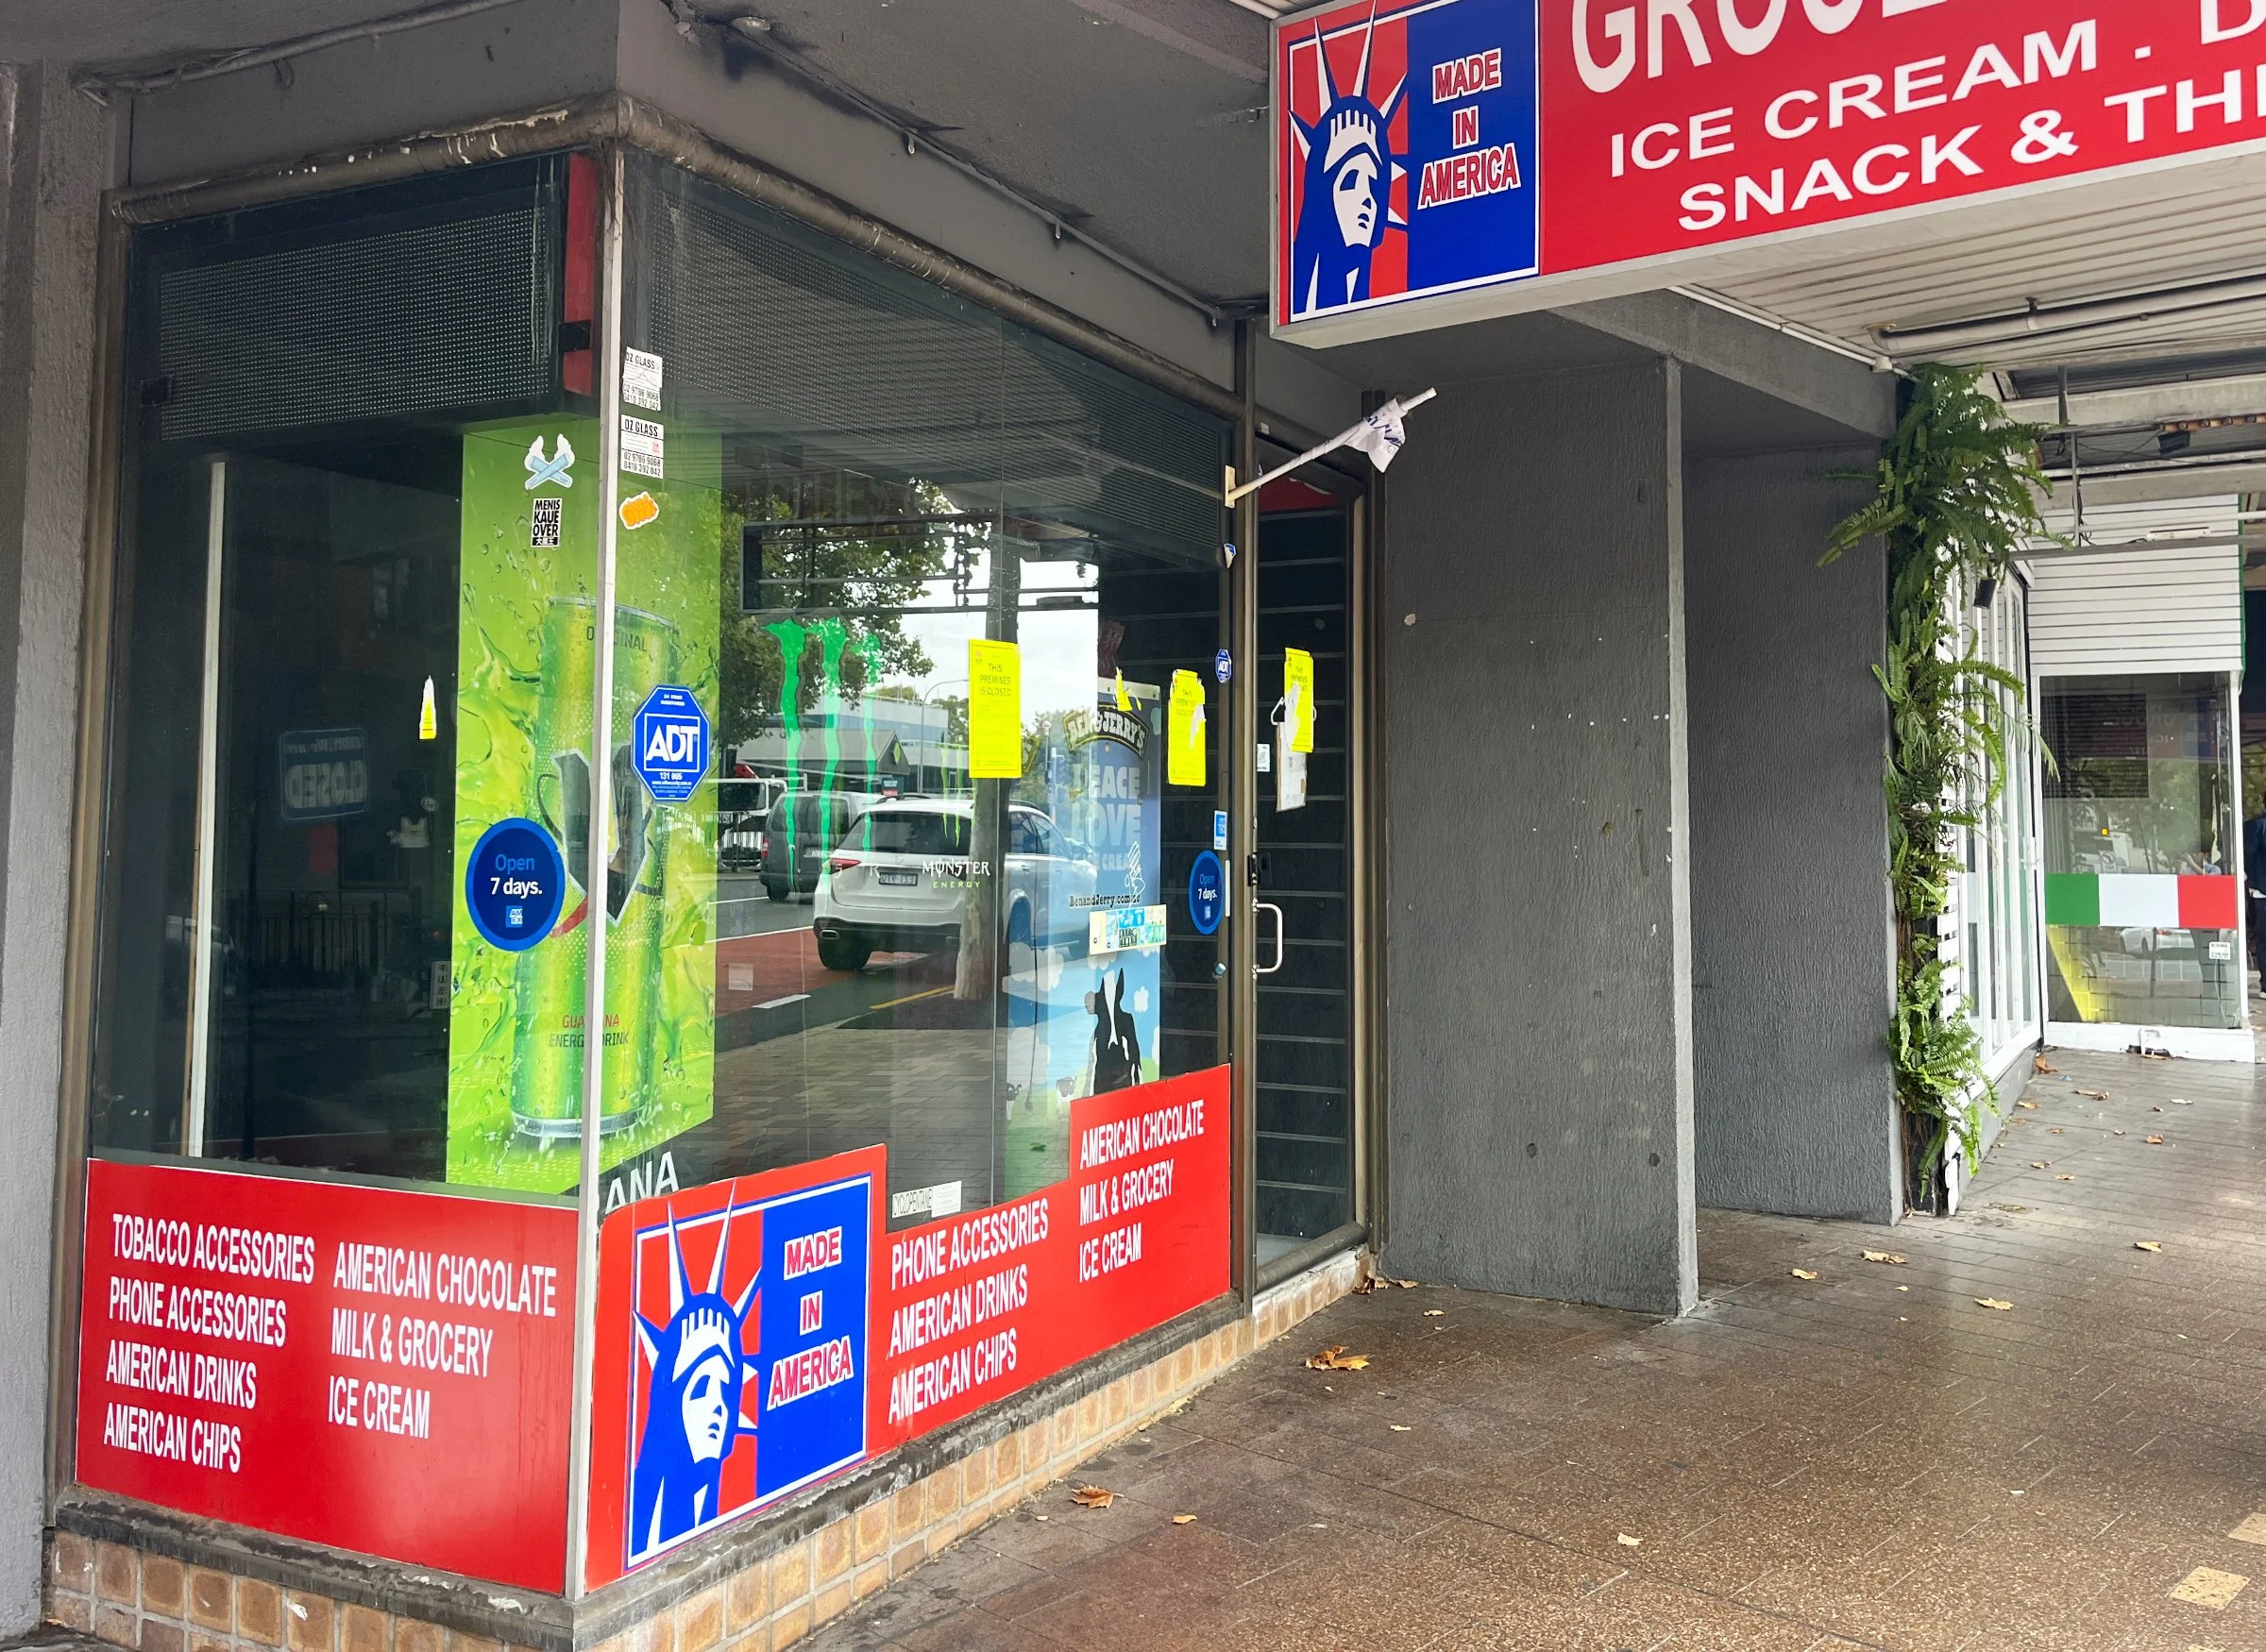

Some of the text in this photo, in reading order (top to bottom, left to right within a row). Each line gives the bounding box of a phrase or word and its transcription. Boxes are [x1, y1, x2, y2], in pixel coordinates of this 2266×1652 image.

[1432, 47, 1501, 104] MADE
[1611, 108, 1735, 177] ICE
[1764, 19, 2097, 140] CREAM
[1453, 105, 1479, 149] IN
[1417, 143, 1521, 210] AMERICA
[1678, 125, 1985, 231] SNACK
[2010, 110, 2079, 164] &
[634, 355, 655, 369] GLASS
[624, 418, 659, 437] OZ GLASS
[533, 510, 560, 524] KAUE
[533, 523, 559, 537] OVER
[535, 498, 561, 511] MENIS
[979, 686, 1011, 698] IS CLOSED
[980, 674, 1011, 685] PREMISES
[988, 663, 1003, 673] THIS
[646, 724, 700, 763] ADT
[1071, 802, 1141, 848] LOVE
[490, 877, 543, 900] 7 days.
[495, 853, 535, 875] Open
[1199, 873, 1215, 886] Open
[1197, 887, 1218, 902] 7 days.
[550, 1031, 630, 1048] ENERG RINK
[563, 1013, 619, 1028] GUANA
[1079, 1100, 1204, 1171] AMERICAN CHOCOLATE
[1079, 1157, 1175, 1226] MILK & GROCERY
[112, 1213, 315, 1285] TOBACCO ACCESSORIES
[784, 1226, 842, 1280] MADE
[891, 1229, 946, 1290] PHONE
[949, 1198, 1049, 1272] ACCESSORIES
[1079, 1222, 1141, 1283] ICE CREAM
[332, 1241, 558, 1318] AMERICAN CHOCOLATE
[109, 1275, 287, 1347] PHONE ACCESSORIES
[800, 1290, 823, 1336] IN
[889, 1264, 1028, 1357] AMERICAN DRINKS
[330, 1306, 494, 1379] MILK & GROCERY
[106, 1339, 257, 1409] AMERICAN DRINKS
[767, 1335, 854, 1411] AMERICA
[888, 1327, 1017, 1424] AMERICAN CHIPS
[328, 1374, 431, 1441] ICE CREAM
[103, 1402, 242, 1474] AMERICAN CHIPS
